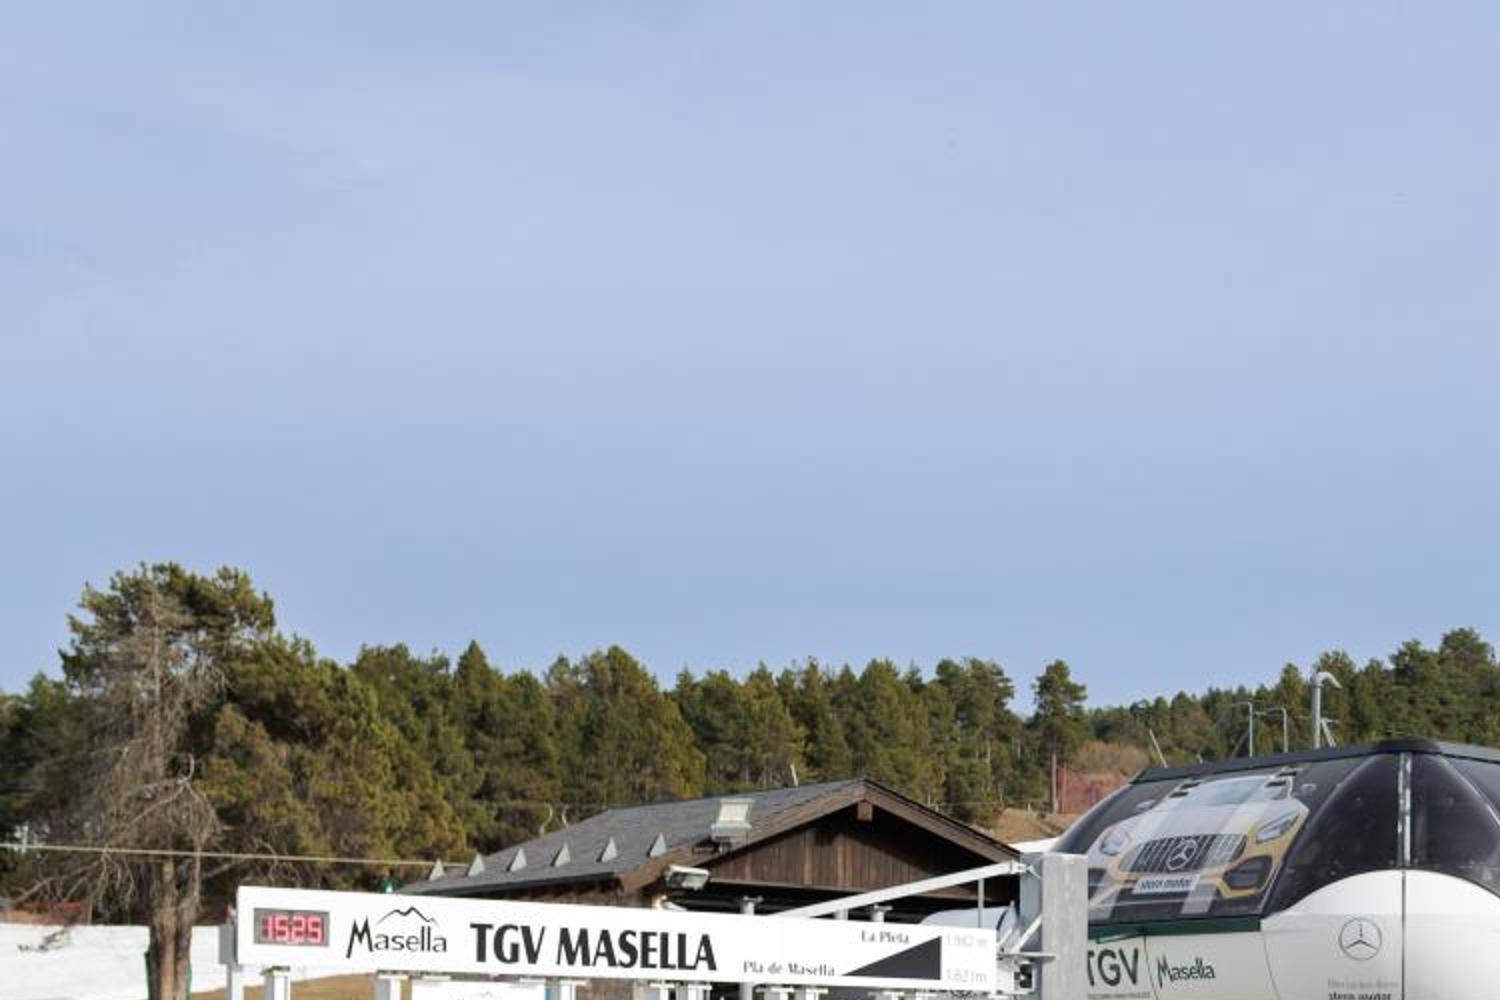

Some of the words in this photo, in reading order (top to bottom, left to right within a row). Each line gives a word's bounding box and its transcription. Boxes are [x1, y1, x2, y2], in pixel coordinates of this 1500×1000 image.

[346, 915, 447, 958] Masella
[470, 923, 546, 964] TGV
[556, 928, 717, 971] MASELLA
[861, 930, 876, 943] La
[743, 961, 764, 974] Pla
[768, 962, 783, 975] de
[788, 963, 835, 977] Masella
[1157, 953, 1216, 988] Masella
